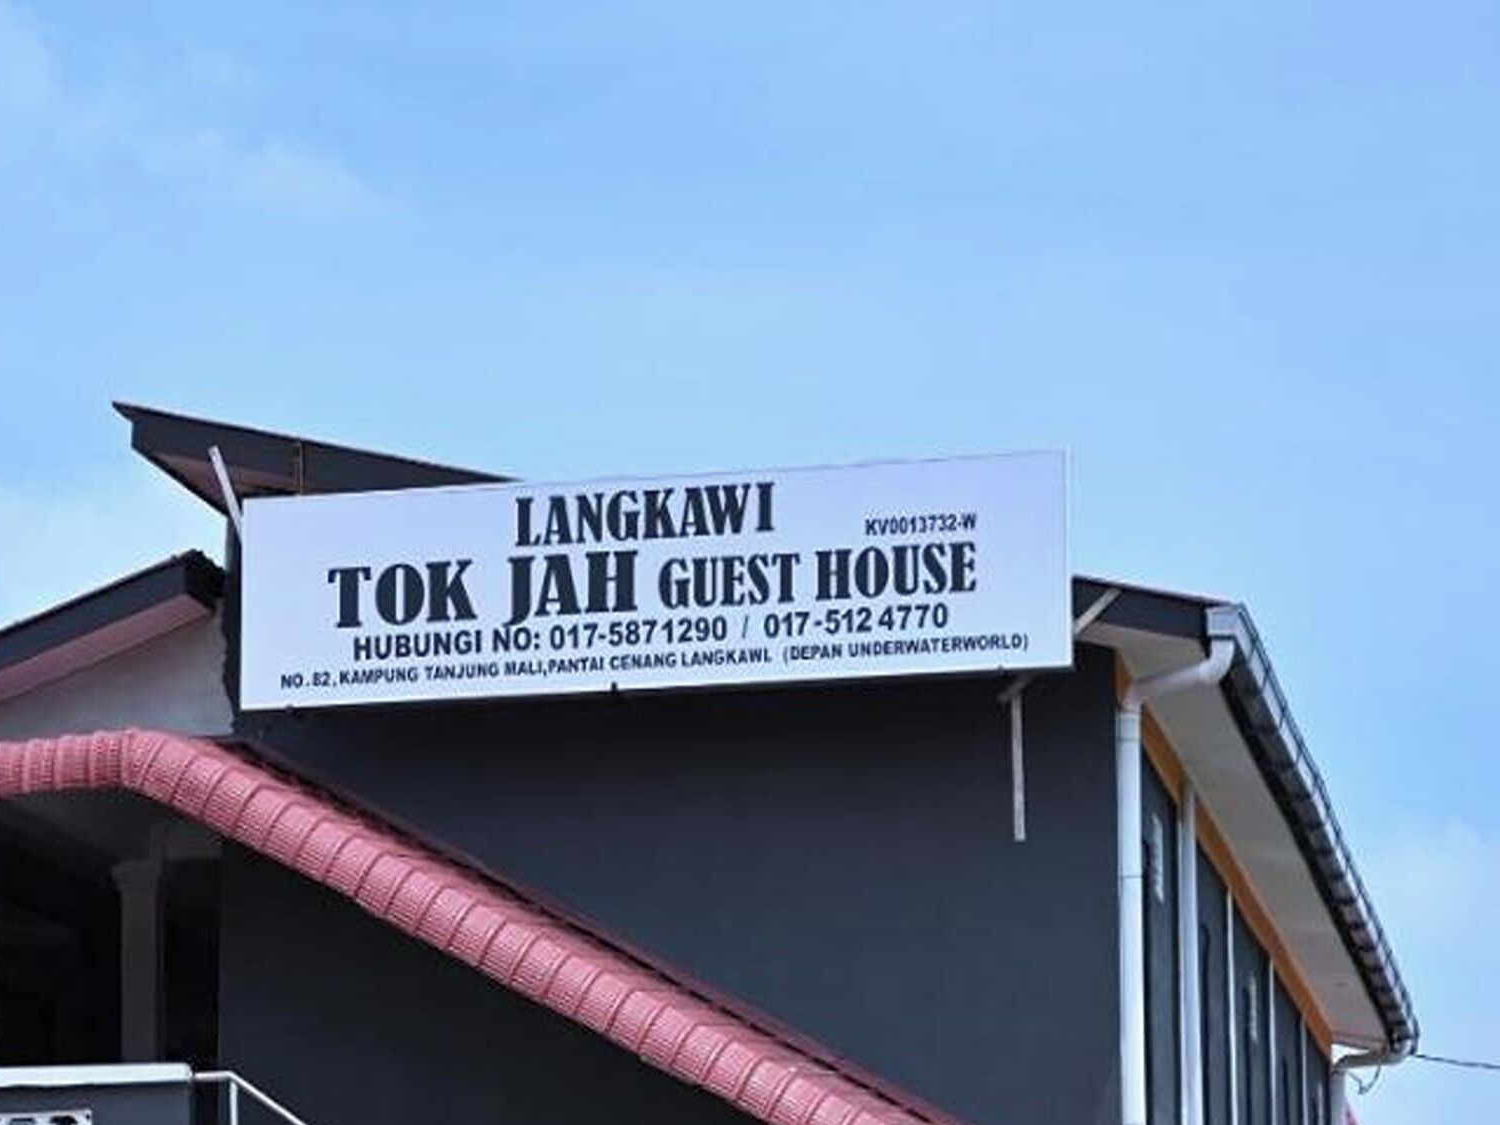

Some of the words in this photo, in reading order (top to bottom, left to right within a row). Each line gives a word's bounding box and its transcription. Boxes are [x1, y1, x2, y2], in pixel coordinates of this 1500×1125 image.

[515, 482, 775, 547] LANGKAWI
[864, 513, 977, 536] KV0013732-W
[327, 559, 478, 628] TOK
[501, 550, 638, 627] JAH
[658, 553, 801, 610] GUEST
[815, 541, 977, 600] HOUSE
[353, 630, 482, 661] HUBUNGI
[492, 626, 540, 652] NO:
[549, 616, 728, 650] 017-5871290
[425, 662, 500, 680] TANJUNG
[609, 652, 677, 671] CENANG
[782, 643, 843, 665] (DEPAN
[850, 632, 1029, 659] UNDERWATERWORLD)
